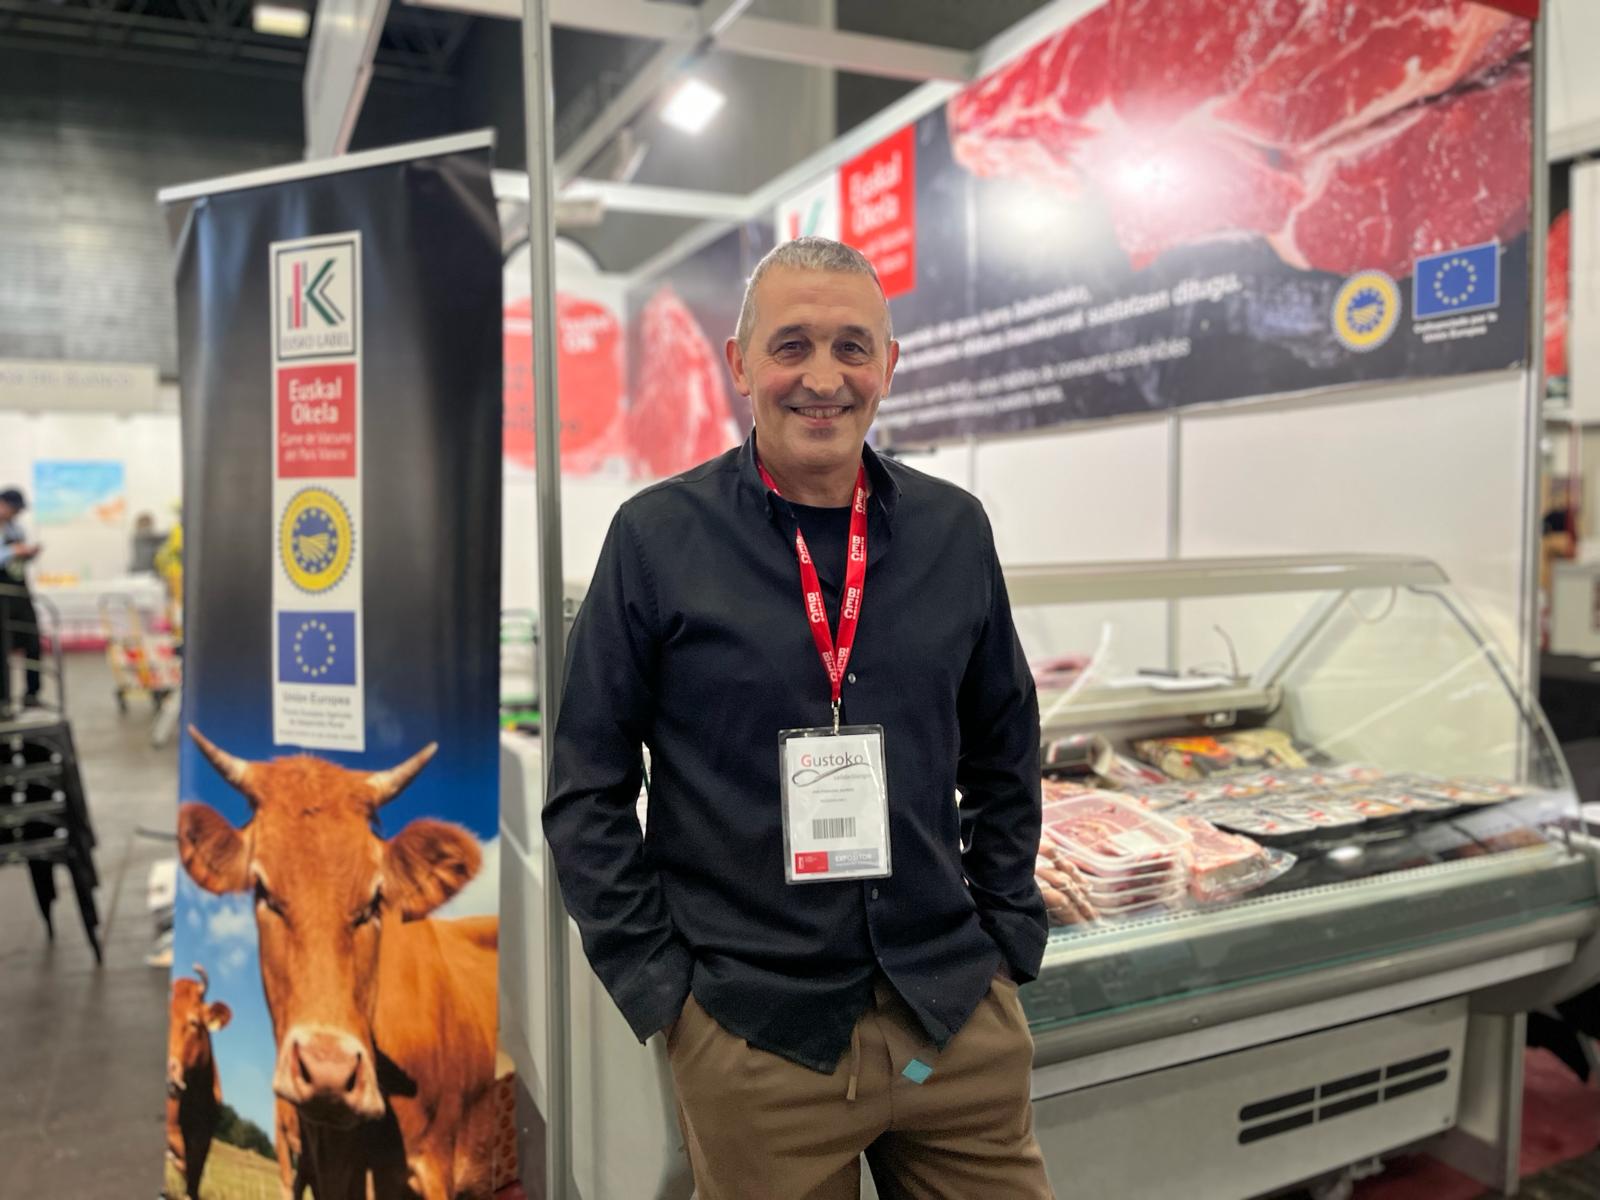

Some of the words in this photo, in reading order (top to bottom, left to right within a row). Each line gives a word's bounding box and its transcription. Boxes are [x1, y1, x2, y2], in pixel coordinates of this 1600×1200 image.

[288, 376, 343, 402] Euskal
[291, 401, 339, 425] Okela
[851, 535, 861, 561] BEC
[807, 592, 821, 624] BEC
[843, 587, 857, 620] BEC
[800, 752, 864, 768] Gustoko
